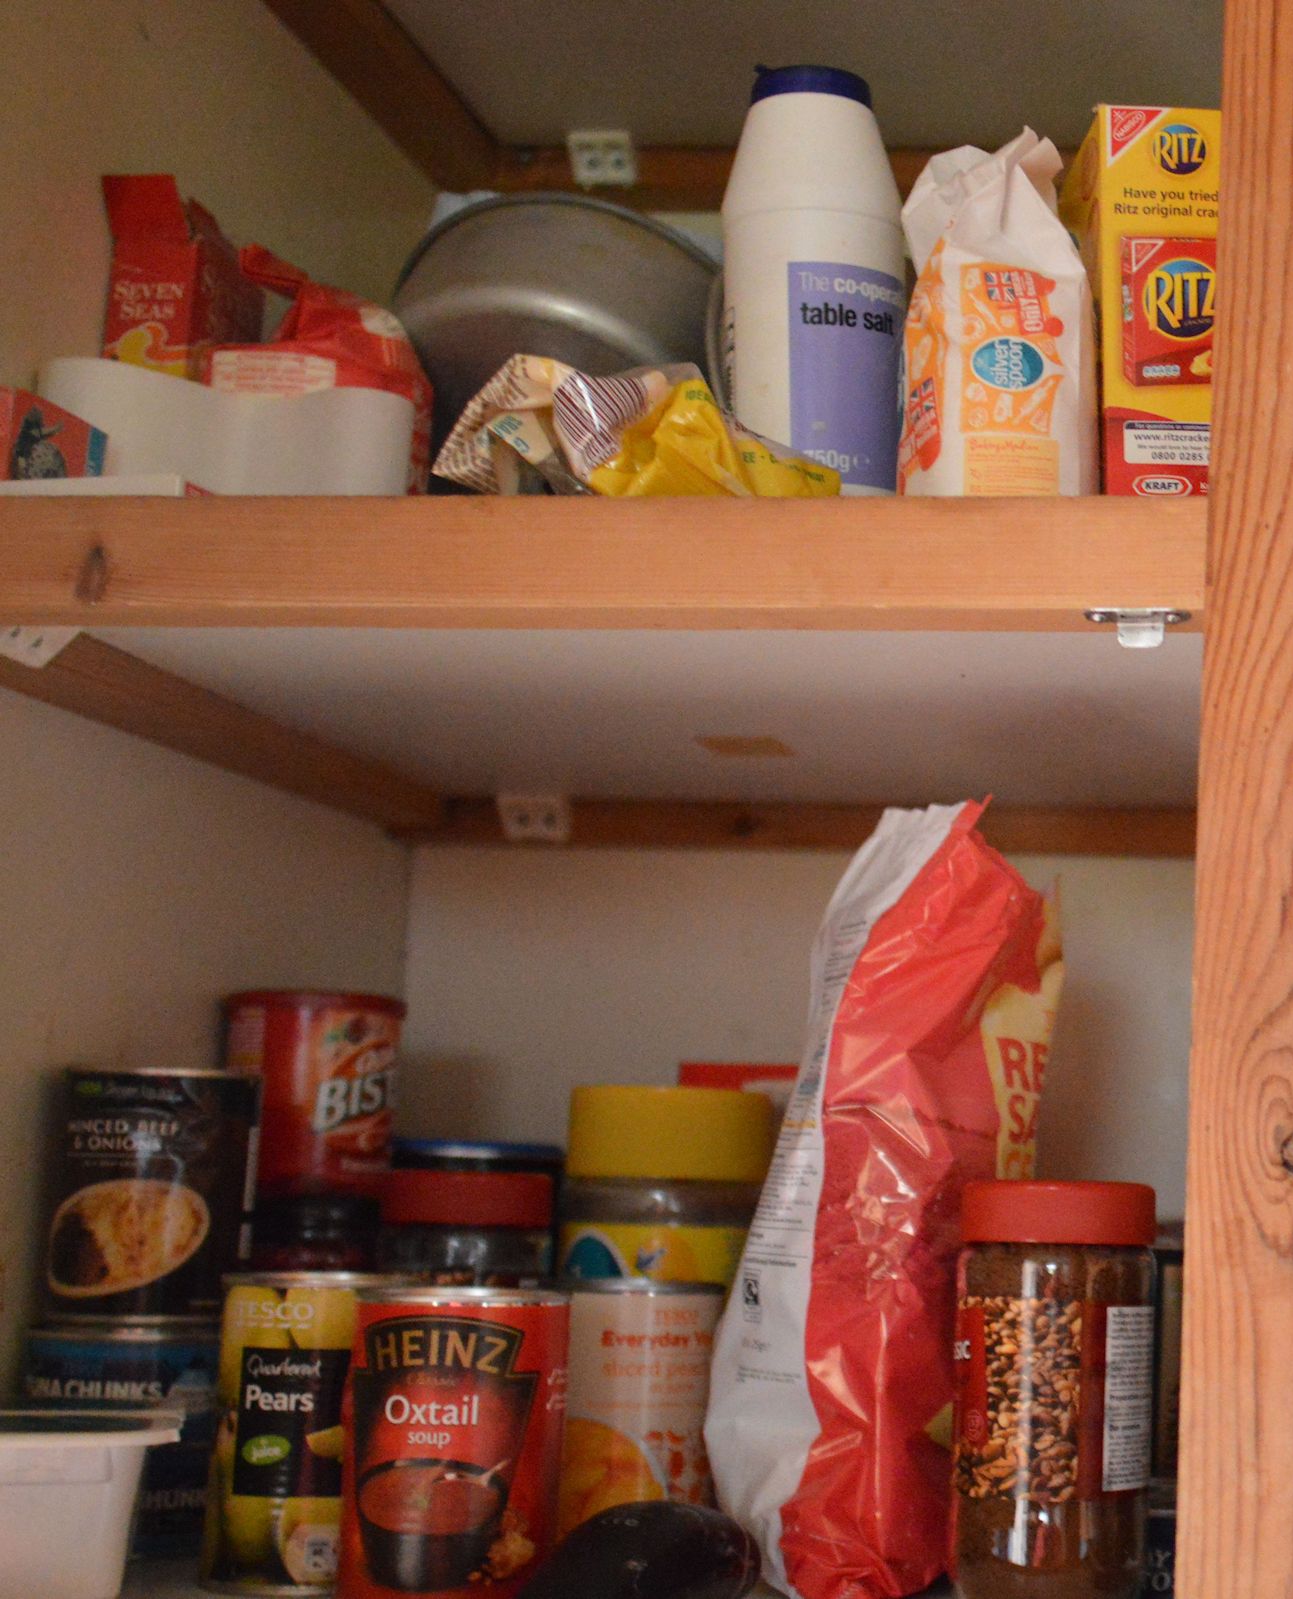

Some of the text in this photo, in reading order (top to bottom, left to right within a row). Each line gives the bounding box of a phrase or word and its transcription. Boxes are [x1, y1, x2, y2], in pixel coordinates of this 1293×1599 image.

[1154, 131, 1204, 170] RITZ
[1123, 187, 1219, 203] Have you tried
[1114, 203, 1139, 215] Ritz
[1142, 204, 1192, 218] original
[114, 281, 185, 300] SEVEN
[800, 271, 831, 292] The
[1148, 268, 1217, 331] RITZ
[120, 301, 176, 319] SEAS
[801, 303, 894, 336] table salt
[993, 340, 1009, 386] silver
[1008, 340, 1024, 389] spoon
[1144, 481, 1180, 491] KRAFT
[137, 1119, 179, 1136] BEEF
[88, 1136, 162, 1152] ONIONS
[233, 1301, 316, 1321] TESCO
[601, 1329, 690, 1349] Everyday
[374, 1328, 509, 1375] HEINZ
[64, 1379, 162, 1400] CHUNKS
[244, 1383, 315, 1413] Pears
[384, 1393, 480, 1426] Oxtail
[407, 1430, 451, 1449] soup
